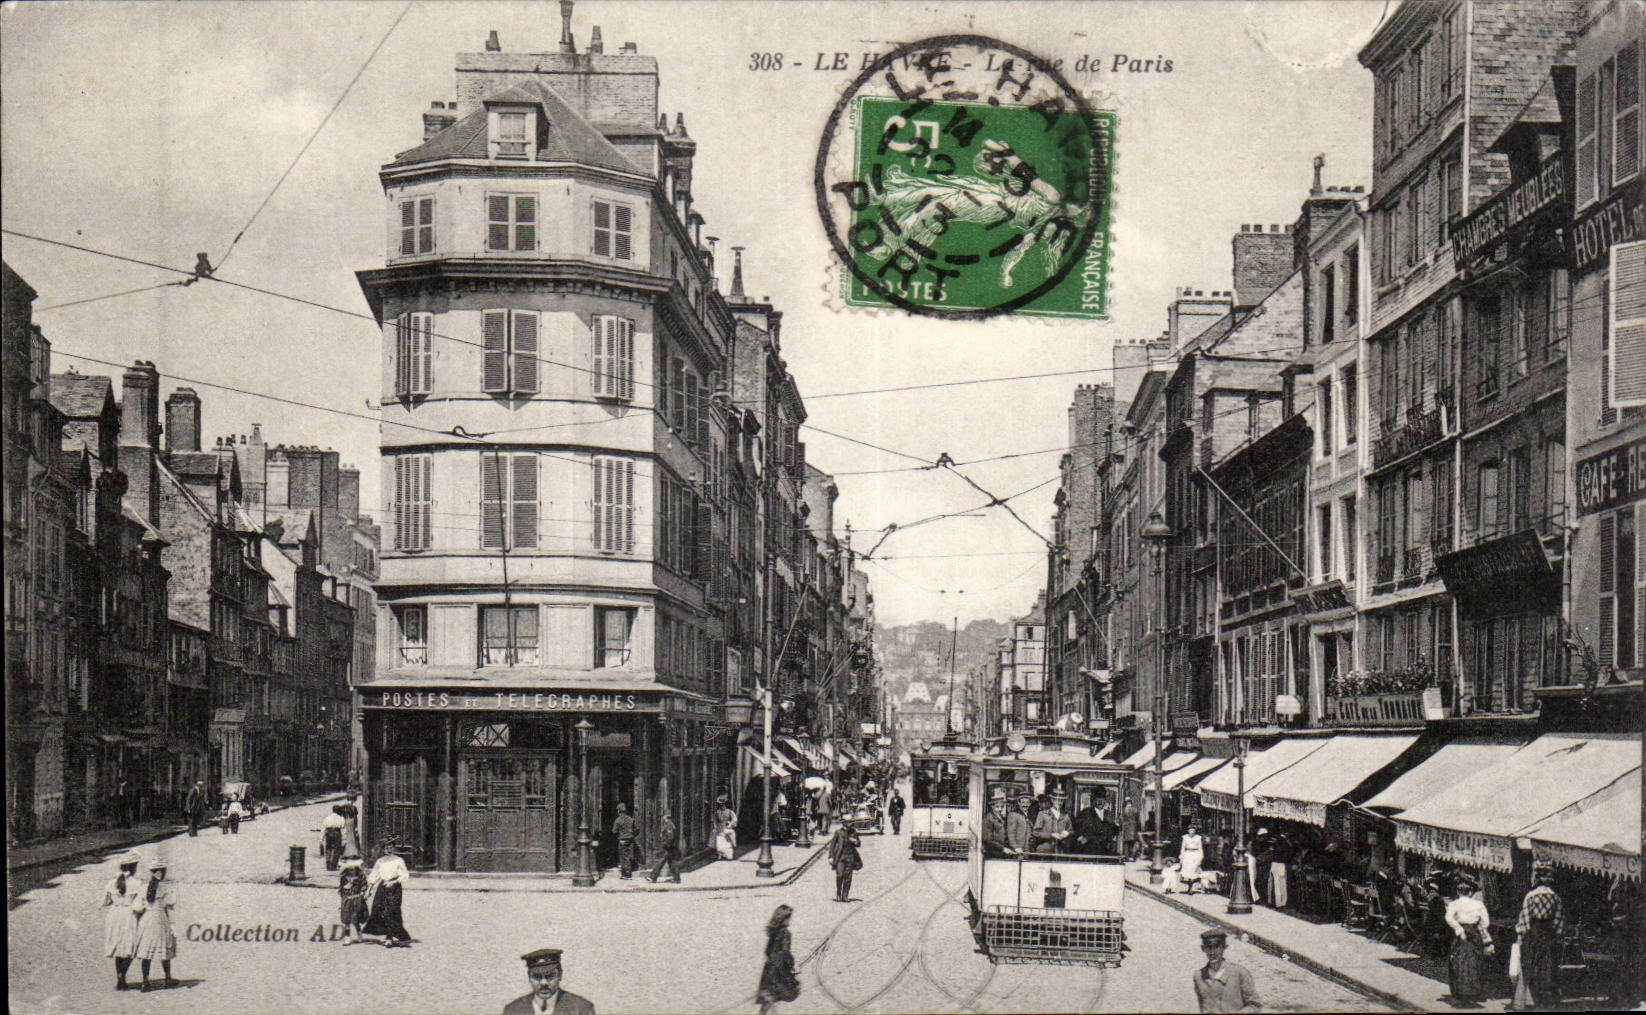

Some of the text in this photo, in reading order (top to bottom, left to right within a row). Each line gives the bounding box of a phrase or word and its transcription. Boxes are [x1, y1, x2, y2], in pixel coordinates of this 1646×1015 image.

[1573, 198, 1633, 269] HOTEL
[382, 692, 637, 710] POSTES ET TELEGRAPHES
[1072, 883, 1082, 896] 7
